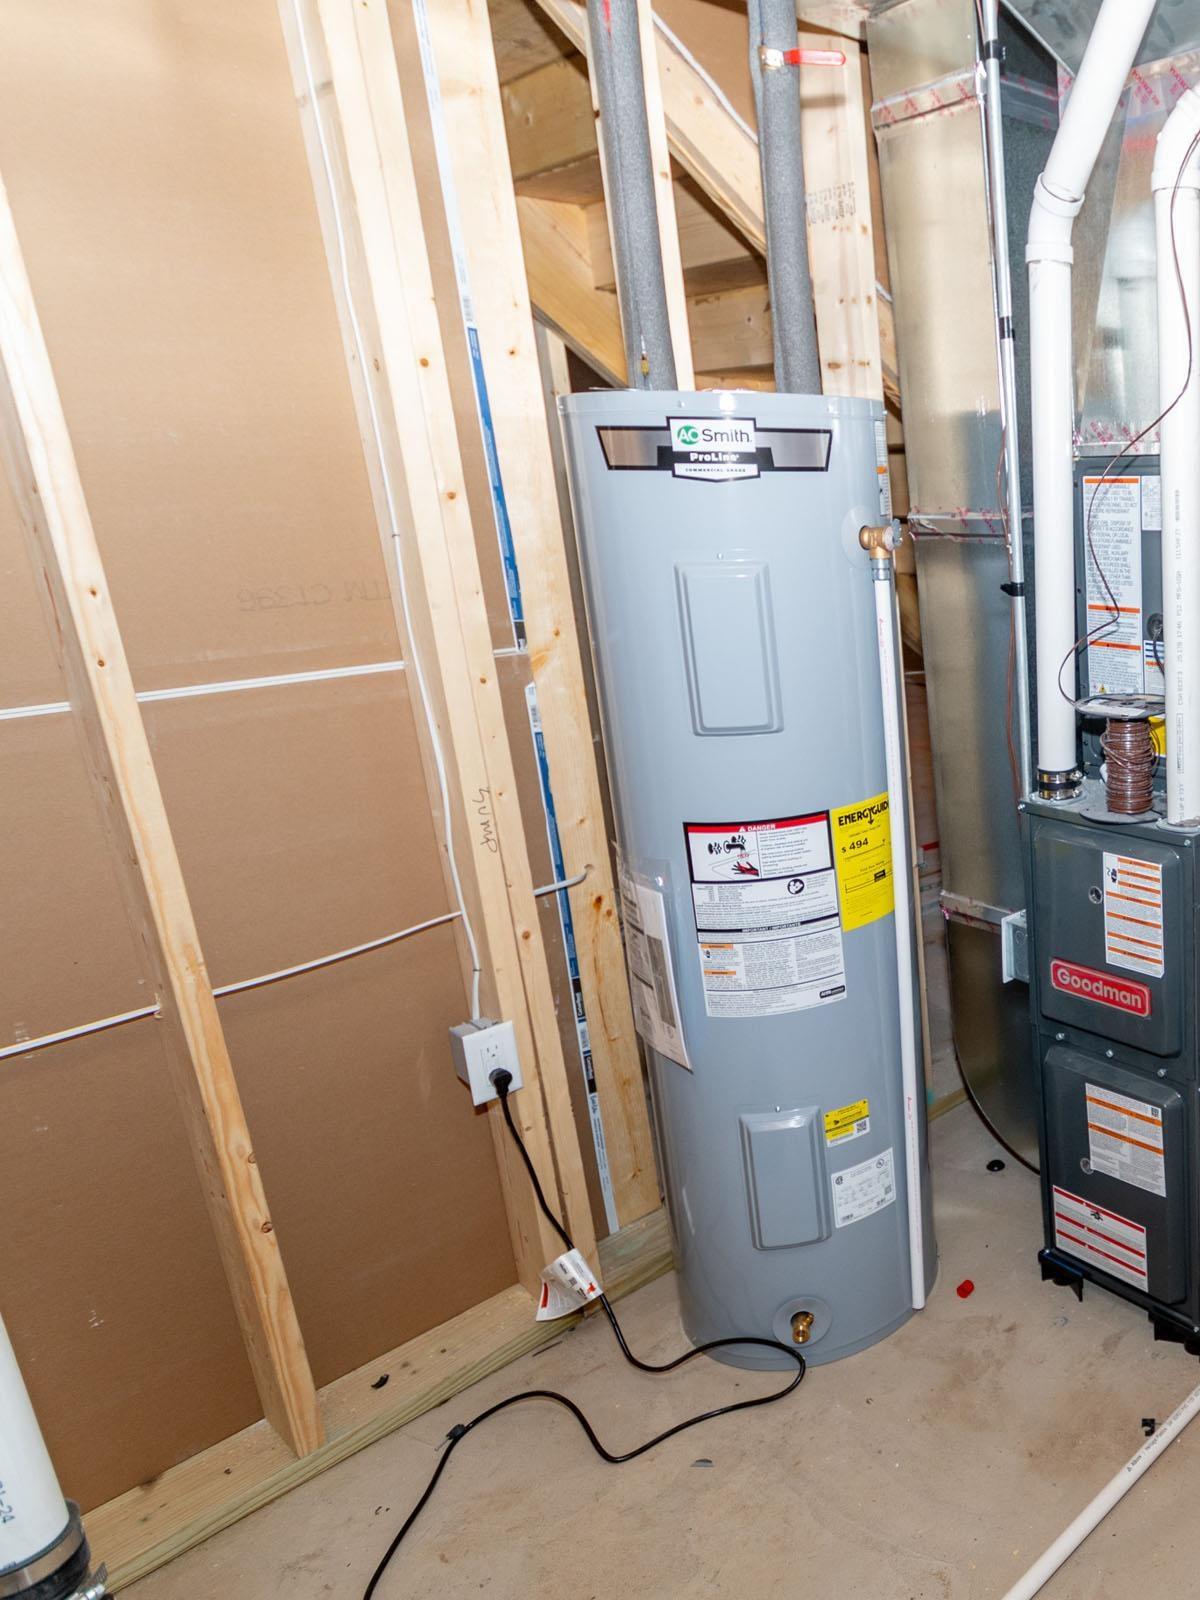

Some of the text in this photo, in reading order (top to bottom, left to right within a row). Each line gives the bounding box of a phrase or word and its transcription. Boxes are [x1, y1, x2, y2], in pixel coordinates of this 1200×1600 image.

[702, 429, 750, 442] Smith
[690, 452, 736, 463] ProLine
[838, 800, 889, 826] ENERGYGUID
[747, 823, 776, 832] DANGER
[849, 837, 869, 850] 494
[1056, 968, 1142, 1009] Goodman
